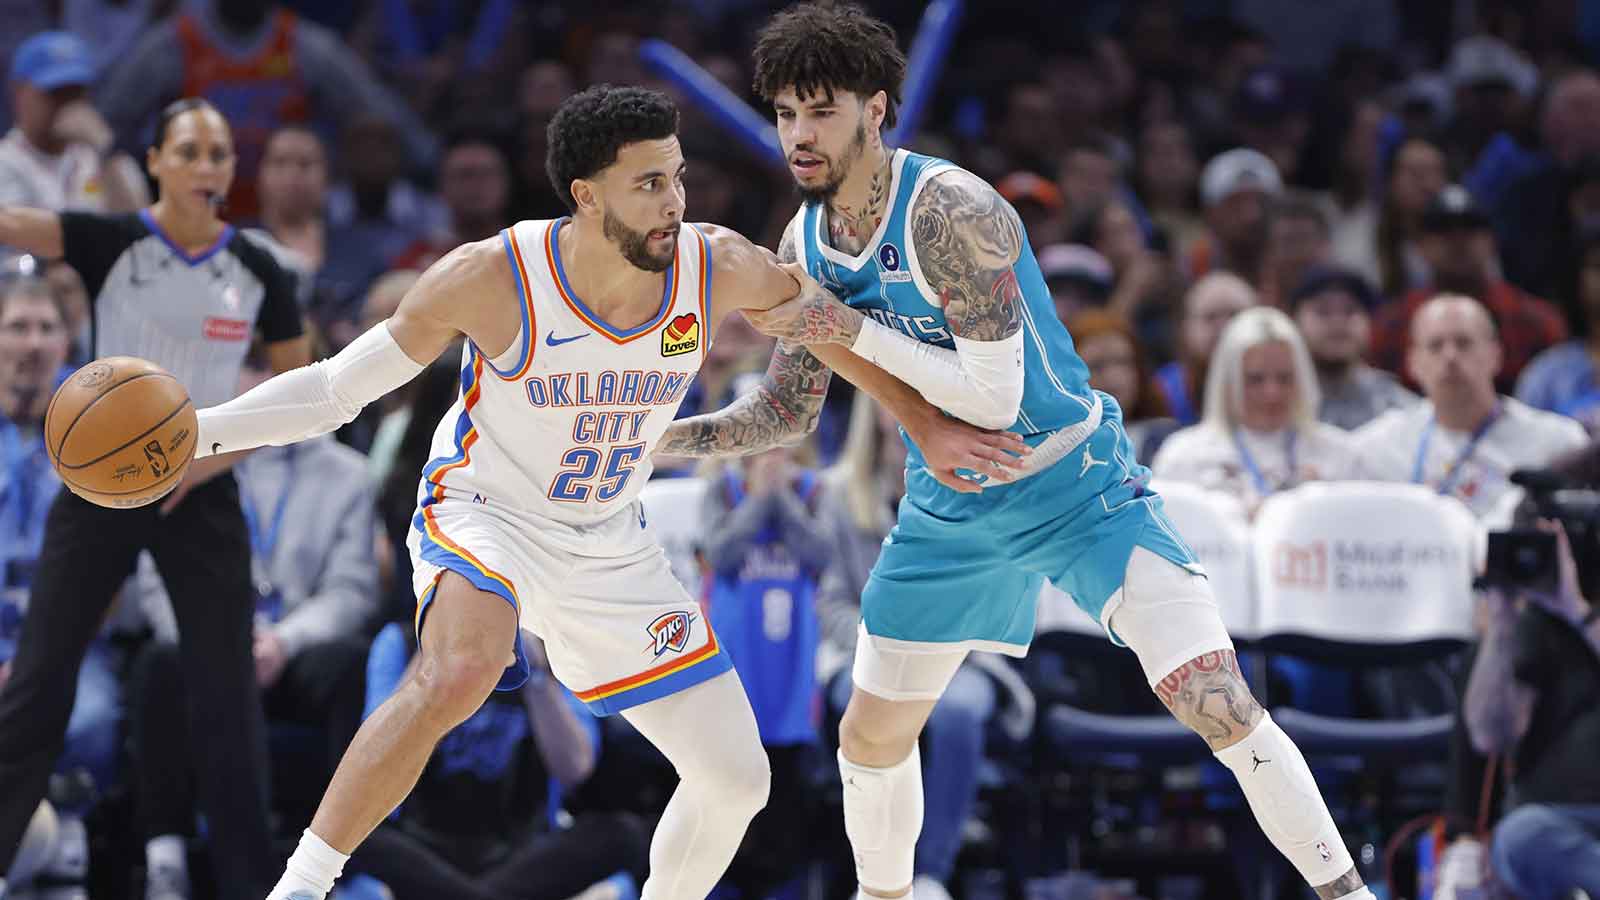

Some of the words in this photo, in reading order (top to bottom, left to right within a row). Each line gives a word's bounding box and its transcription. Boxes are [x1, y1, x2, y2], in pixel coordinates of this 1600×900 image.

[664, 337, 696, 353] Love's
[573, 410, 651, 443] CITY
[548, 442, 646, 503] 25
[655, 615, 682, 655] OKC
